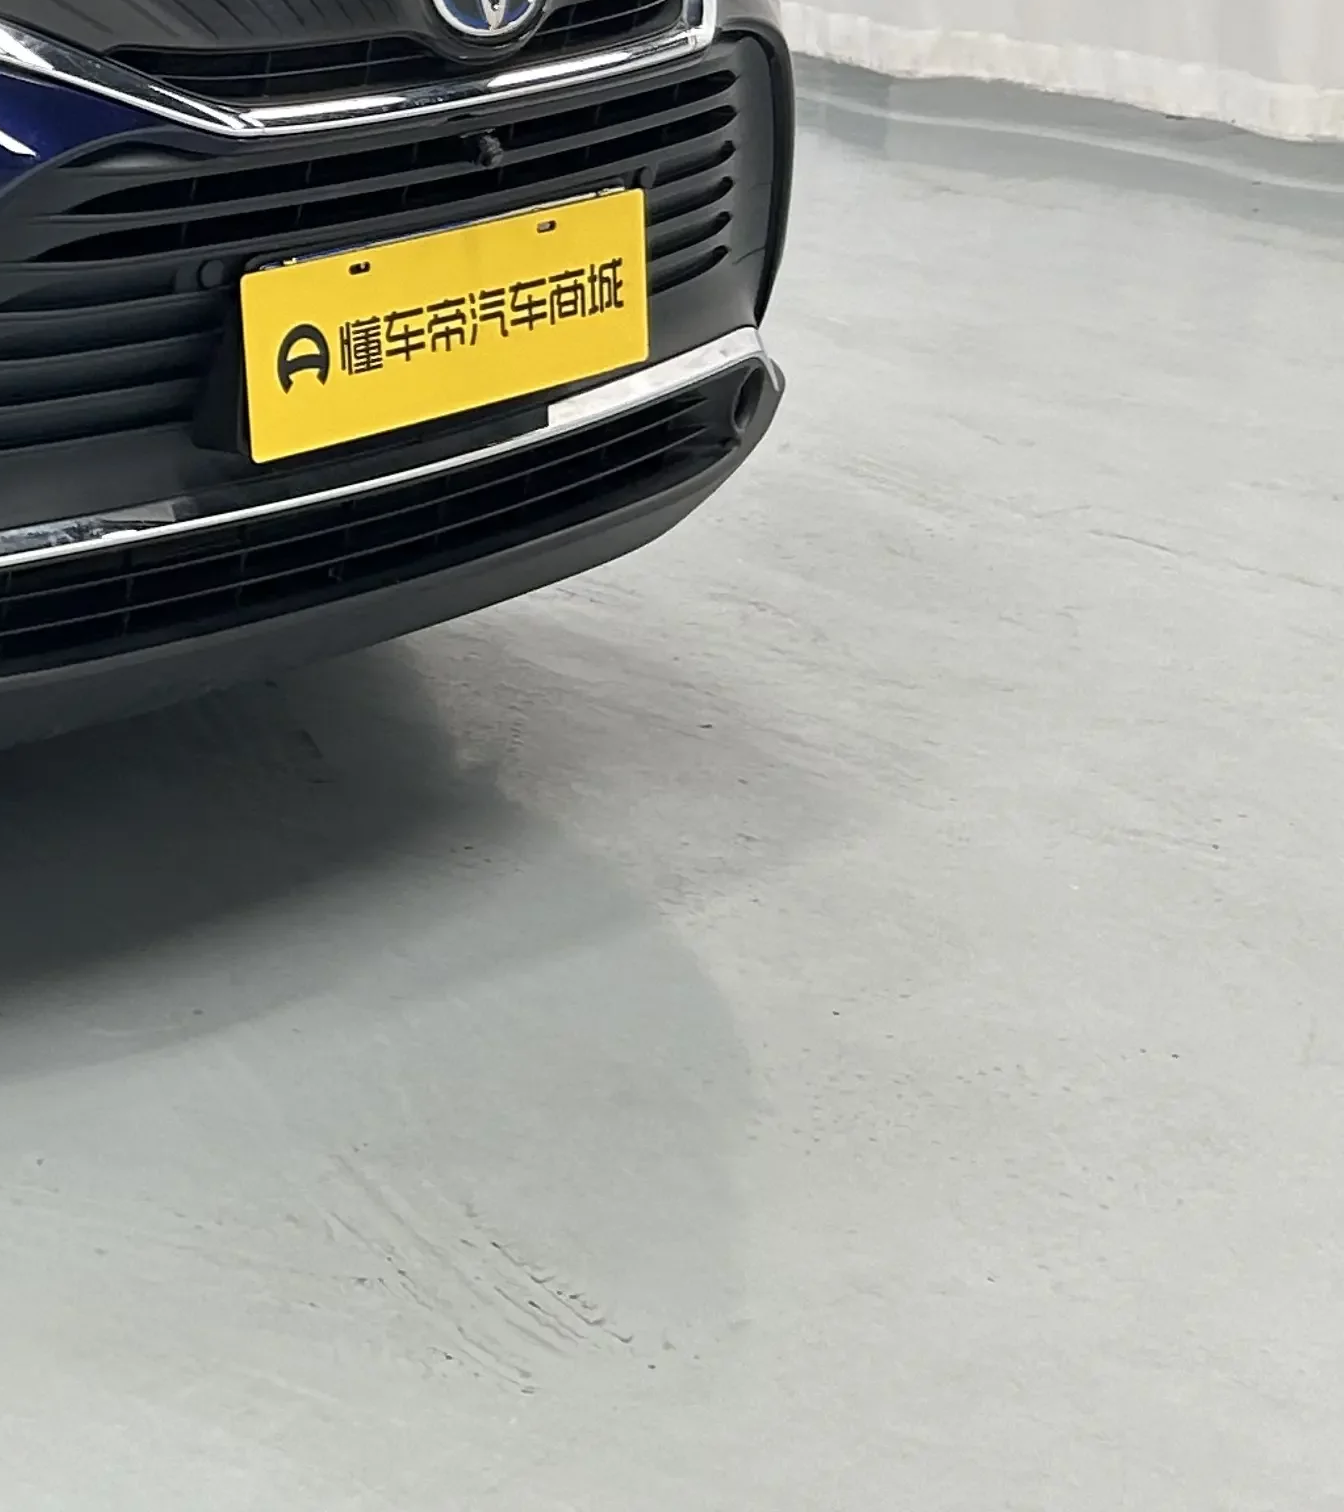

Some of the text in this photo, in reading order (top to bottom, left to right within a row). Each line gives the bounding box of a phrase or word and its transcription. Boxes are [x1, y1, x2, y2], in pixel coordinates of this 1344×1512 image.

[338, 257, 624, 376] 懂车帝汽车商城
